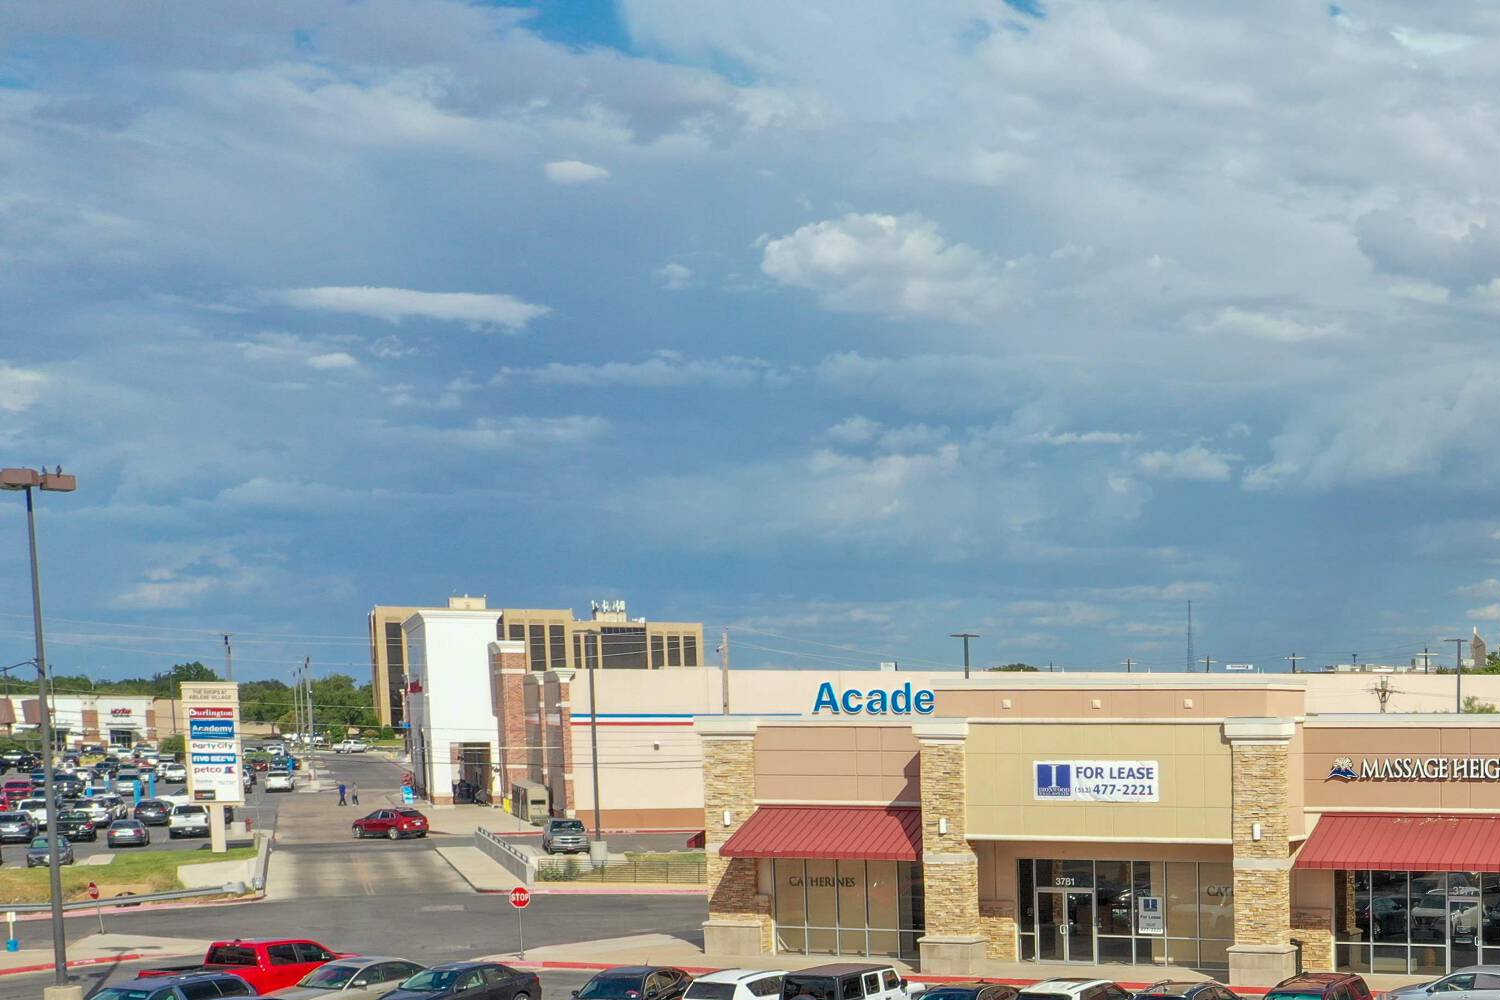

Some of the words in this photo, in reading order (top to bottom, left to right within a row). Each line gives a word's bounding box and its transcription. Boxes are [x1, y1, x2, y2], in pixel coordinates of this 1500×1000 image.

[812, 681, 936, 714] Acade
[190, 708, 233, 719] Burlington
[192, 725, 233, 733] Academy
[193, 766, 222, 774] petco
[1075, 766, 1104, 780] FOR
[1109, 767, 1155, 780] LEASE
[1361, 758, 1450, 779] MASSAGE
[1093, 784, 1155, 796] 477-2221
[788, 875, 858, 889] CAHERINES
[1055, 877, 1075, 886] 3781
[510, 893, 530, 902] STOP
